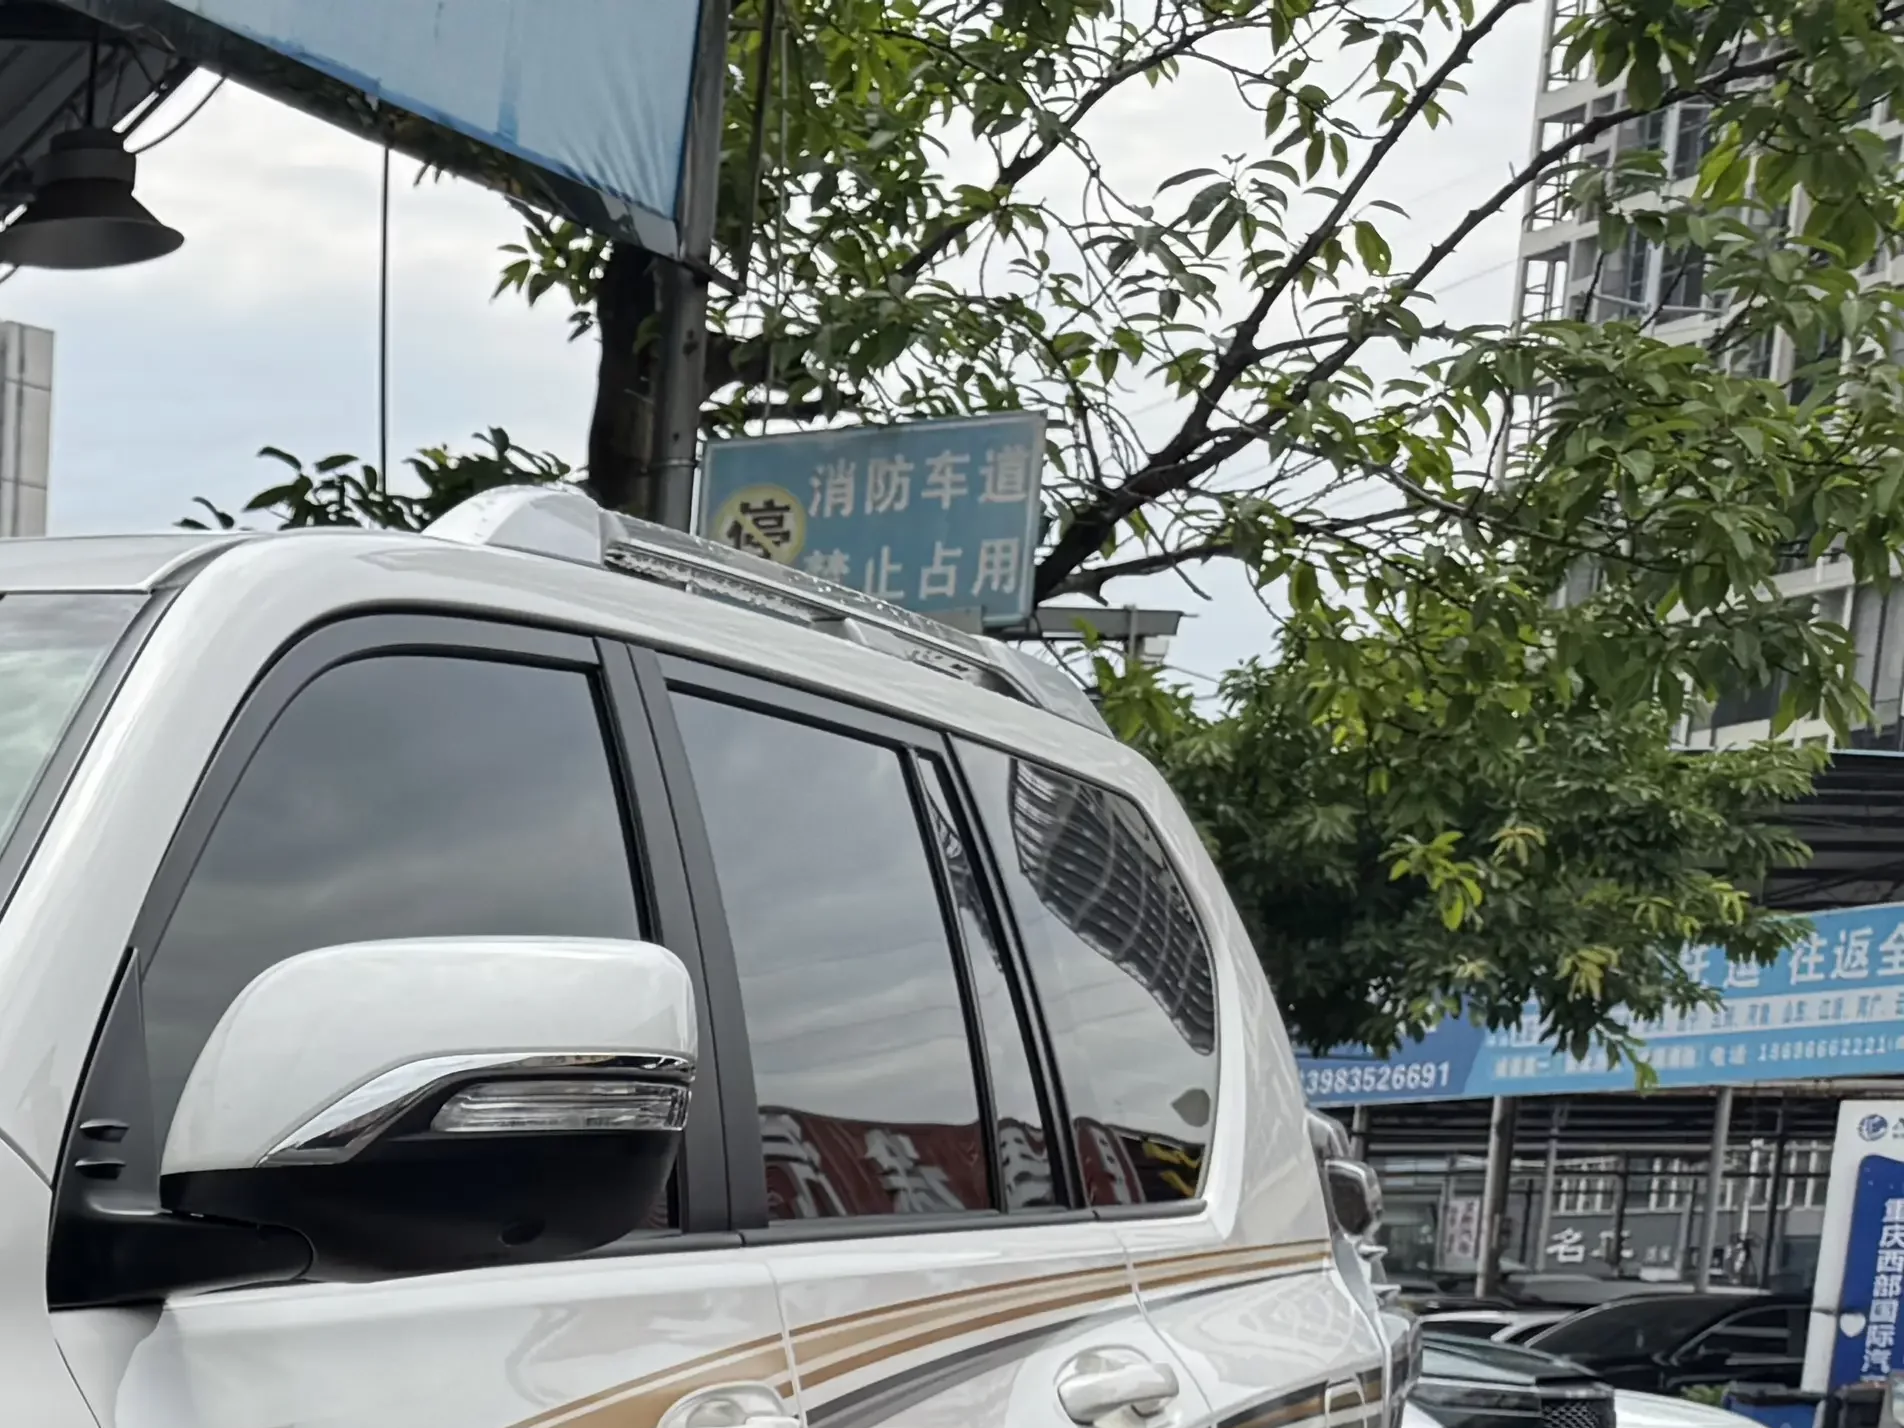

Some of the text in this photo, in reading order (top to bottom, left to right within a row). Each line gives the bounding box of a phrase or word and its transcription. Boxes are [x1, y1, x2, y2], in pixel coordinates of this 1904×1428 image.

[807, 444, 1034, 519] 消防车道
[1861, 1198, 1904, 1384] 重庆西部国际汽
